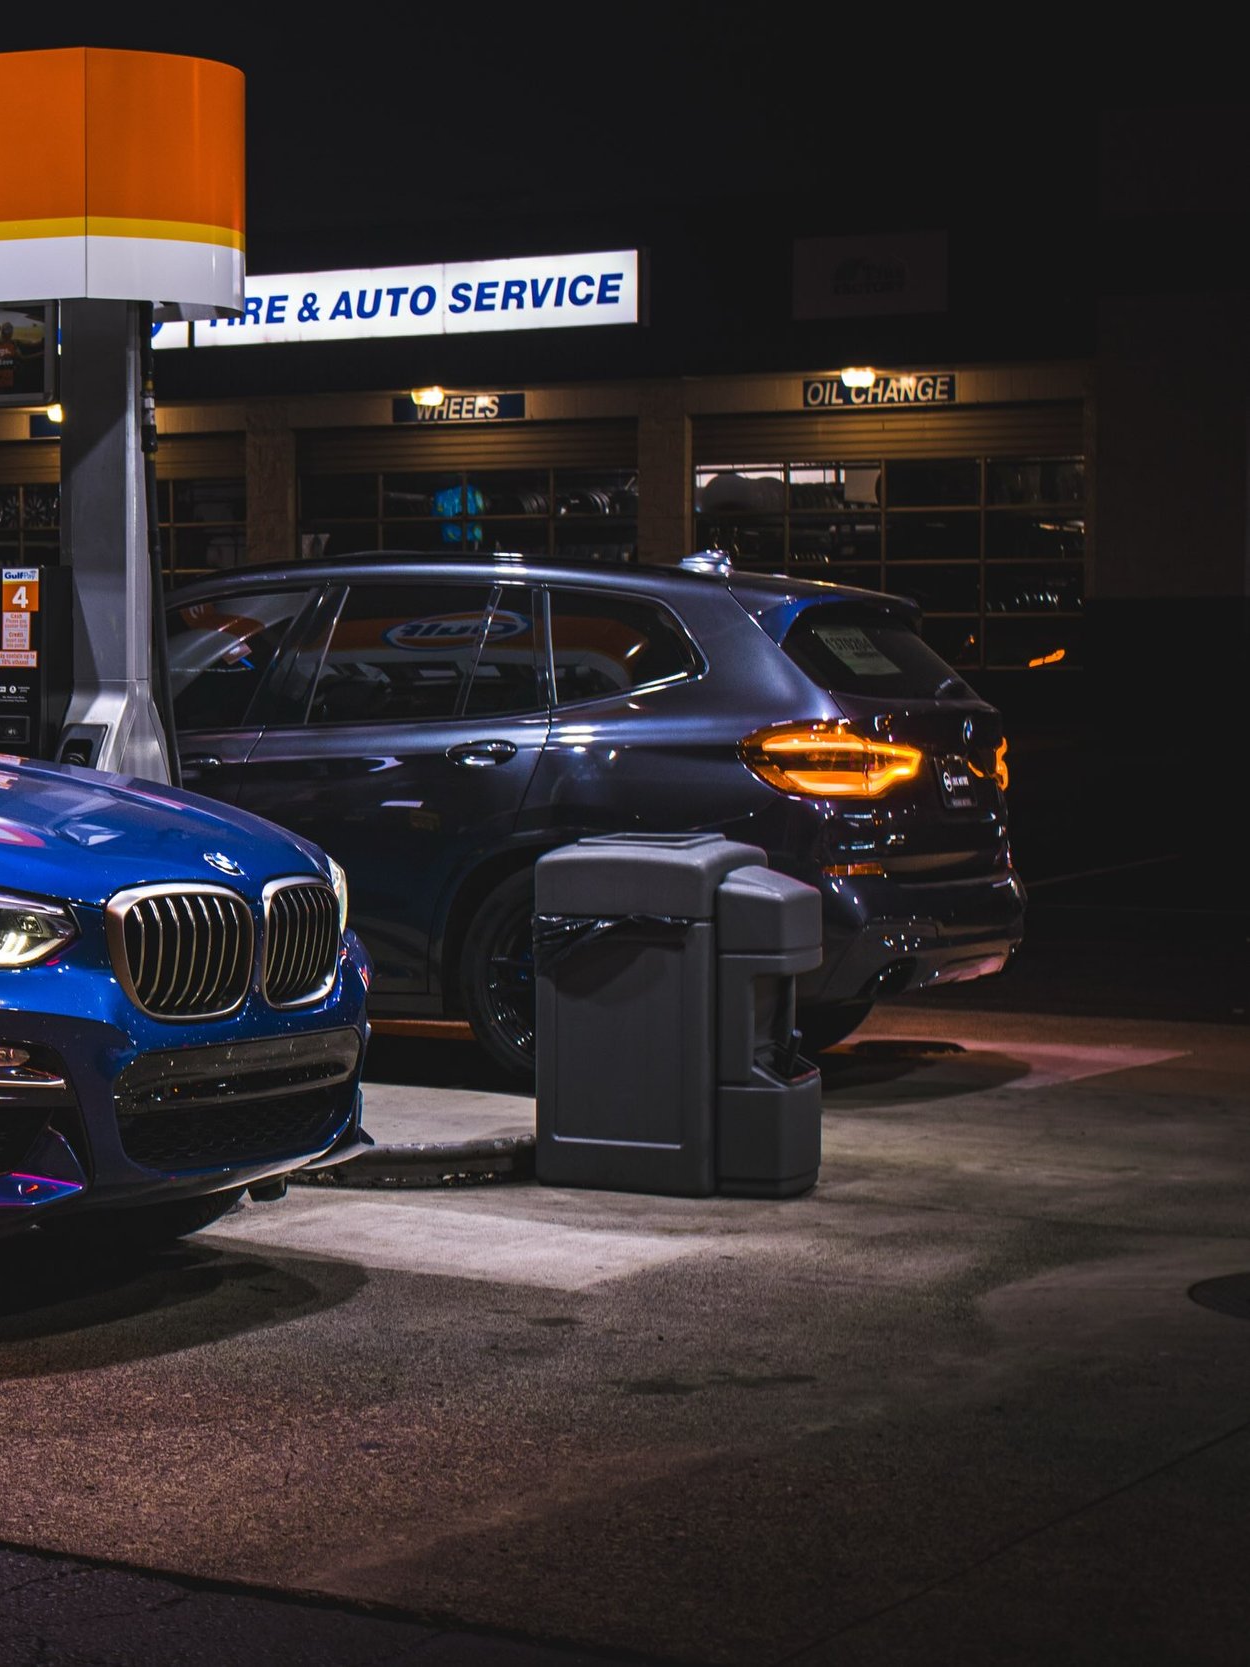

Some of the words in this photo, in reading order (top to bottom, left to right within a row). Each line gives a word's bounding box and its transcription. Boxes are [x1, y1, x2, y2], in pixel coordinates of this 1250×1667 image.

[209, 294, 289, 327] RE
[297, 292, 320, 322] &
[329, 285, 437, 321] AUTO
[449, 272, 624, 314] SERVICE
[806, 381, 844, 406] OIL
[850, 376, 951, 405] CHANGE
[416, 395, 500, 420] WHEELS
[4, 570, 36, 580] GulfPay
[12, 585, 29, 609] 4
